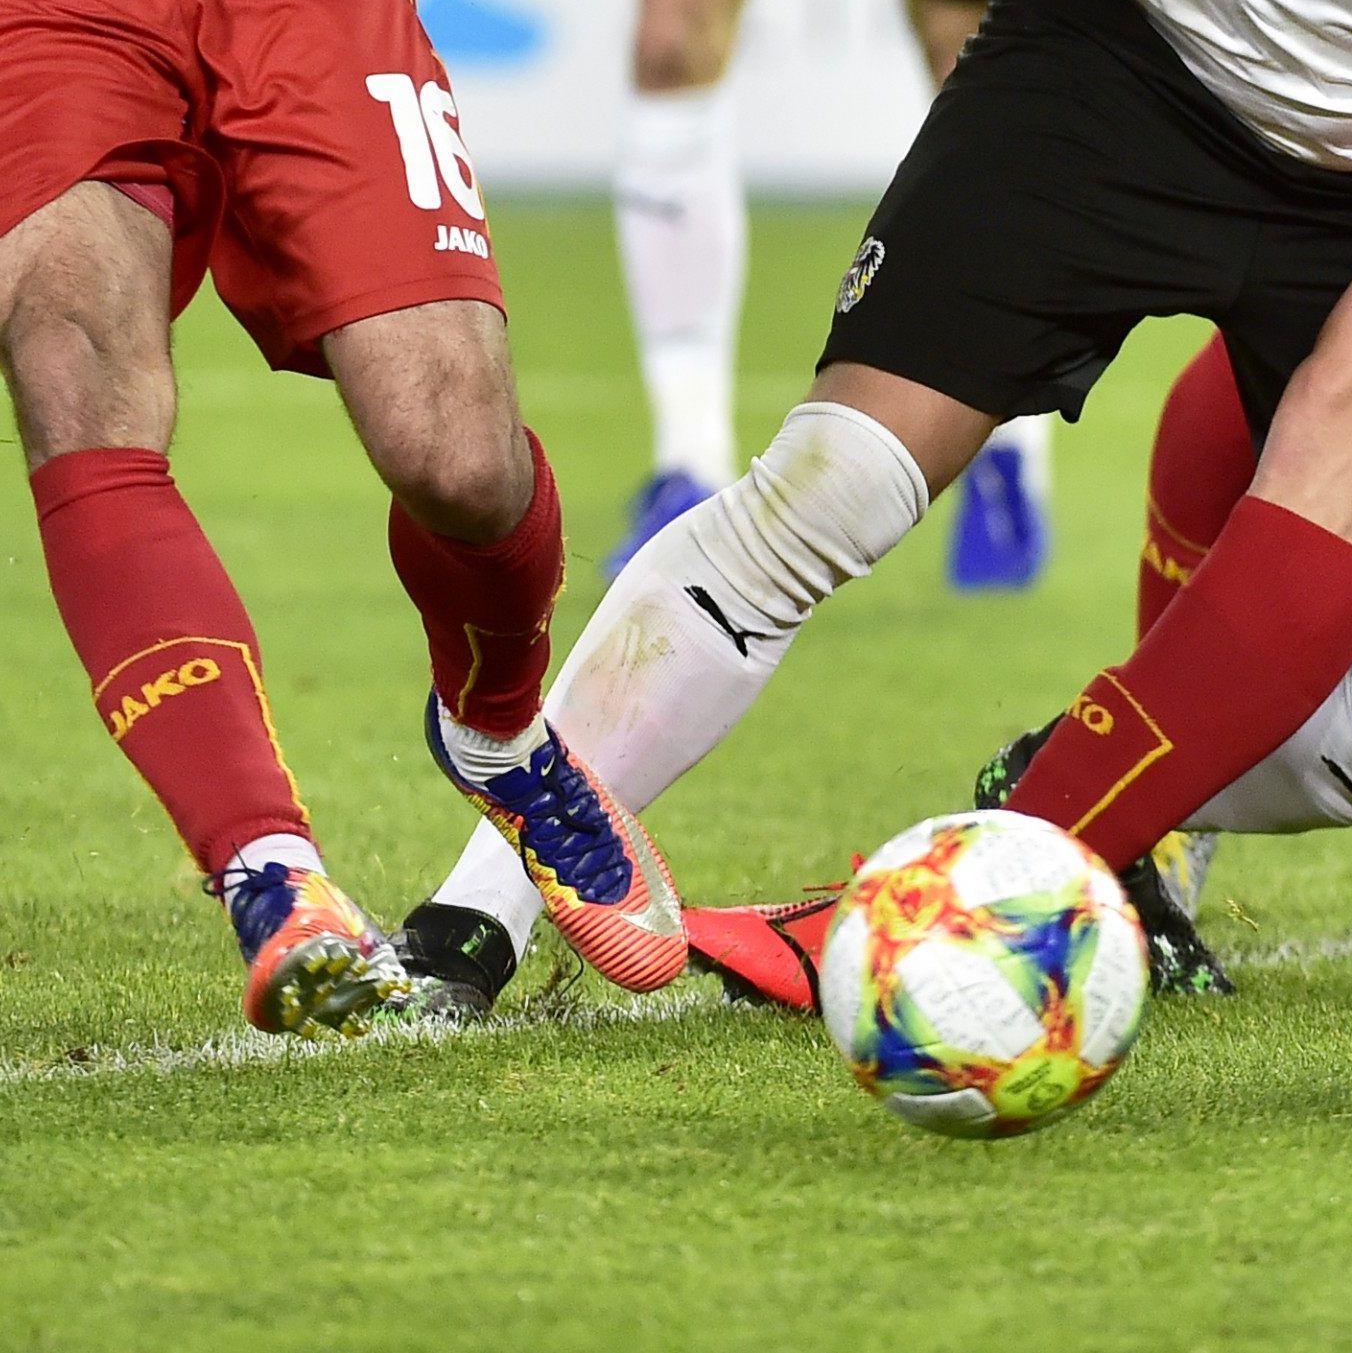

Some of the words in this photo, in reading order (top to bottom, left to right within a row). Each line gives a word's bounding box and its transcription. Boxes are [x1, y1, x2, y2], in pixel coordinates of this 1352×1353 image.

[365, 72, 485, 221] 16
[434, 224, 489, 260] JAKO
[110, 657, 221, 741] JAKO
